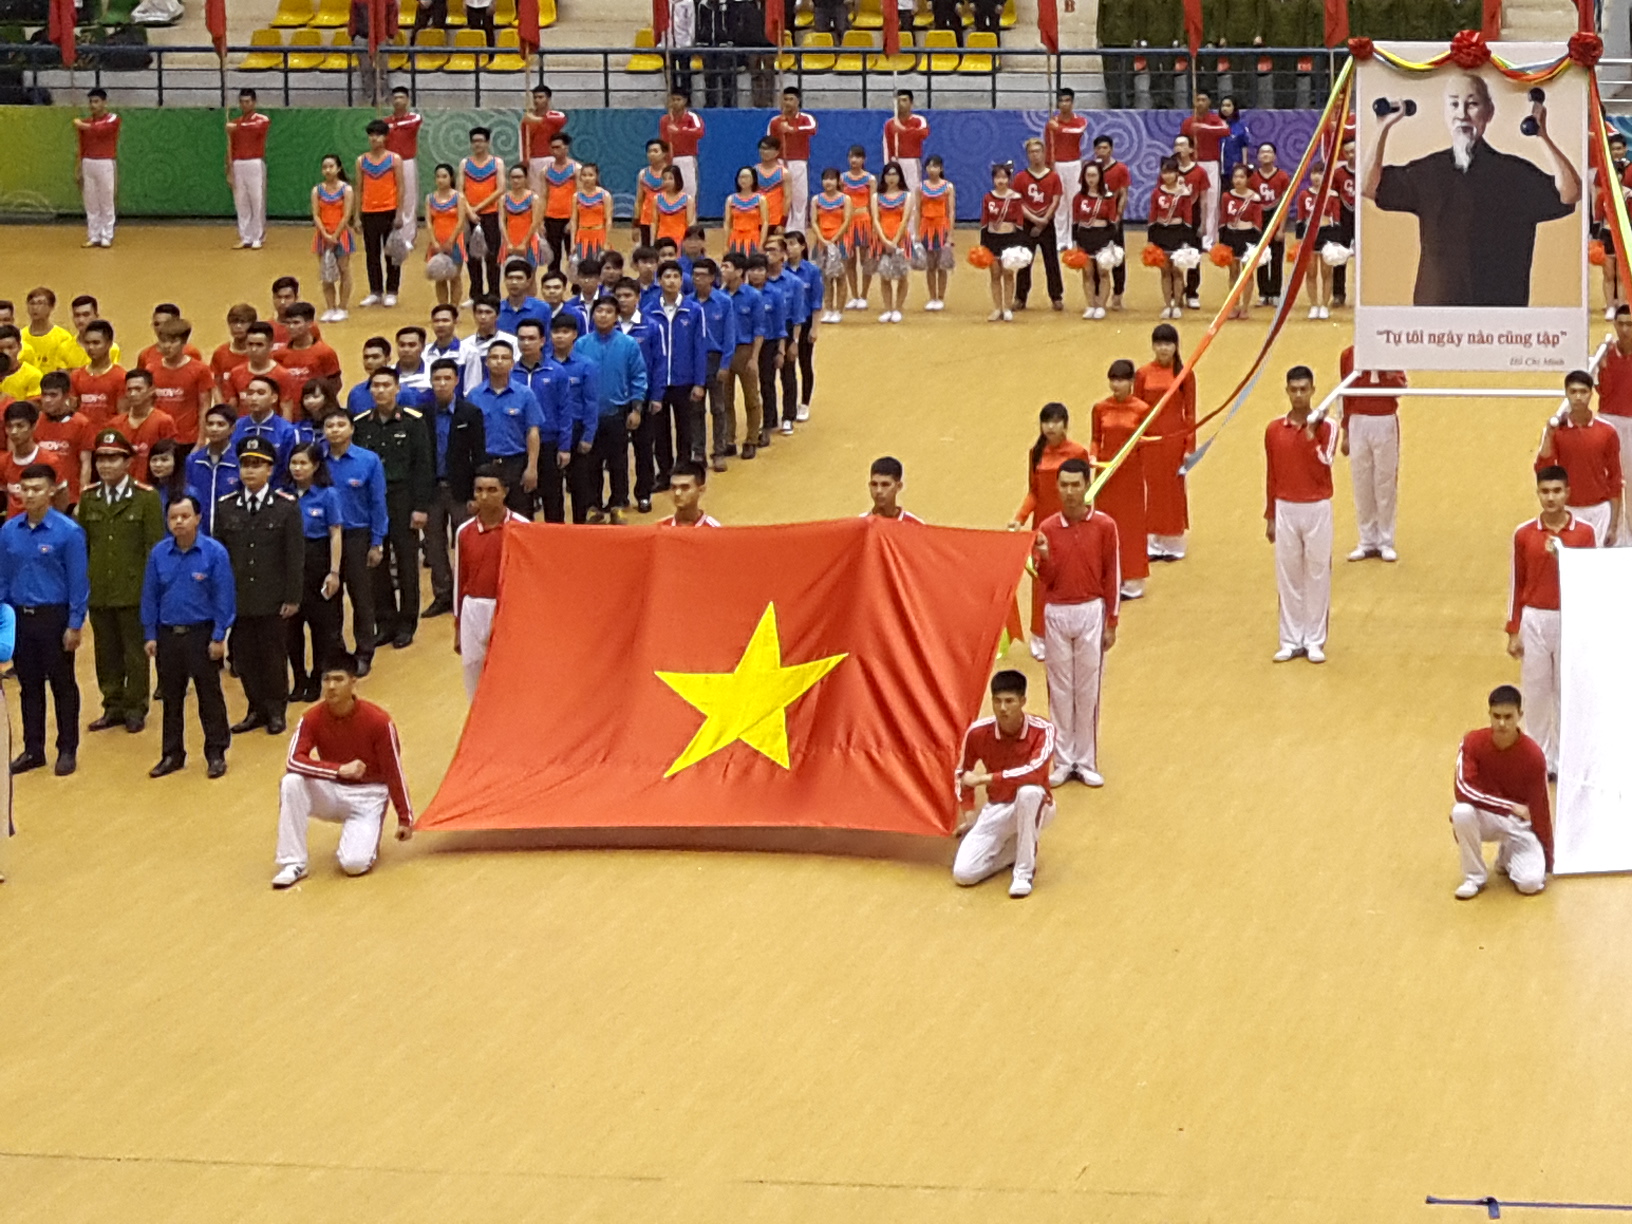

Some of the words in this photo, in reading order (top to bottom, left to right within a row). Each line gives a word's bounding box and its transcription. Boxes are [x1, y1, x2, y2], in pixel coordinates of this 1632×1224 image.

[1064, 0, 1076, 13] B
[1406, 329, 1424, 344] tôi
[1428, 330, 1463, 347] ngày
[1467, 329, 1494, 344] nào
[1498, 330, 1532, 348] cũng
